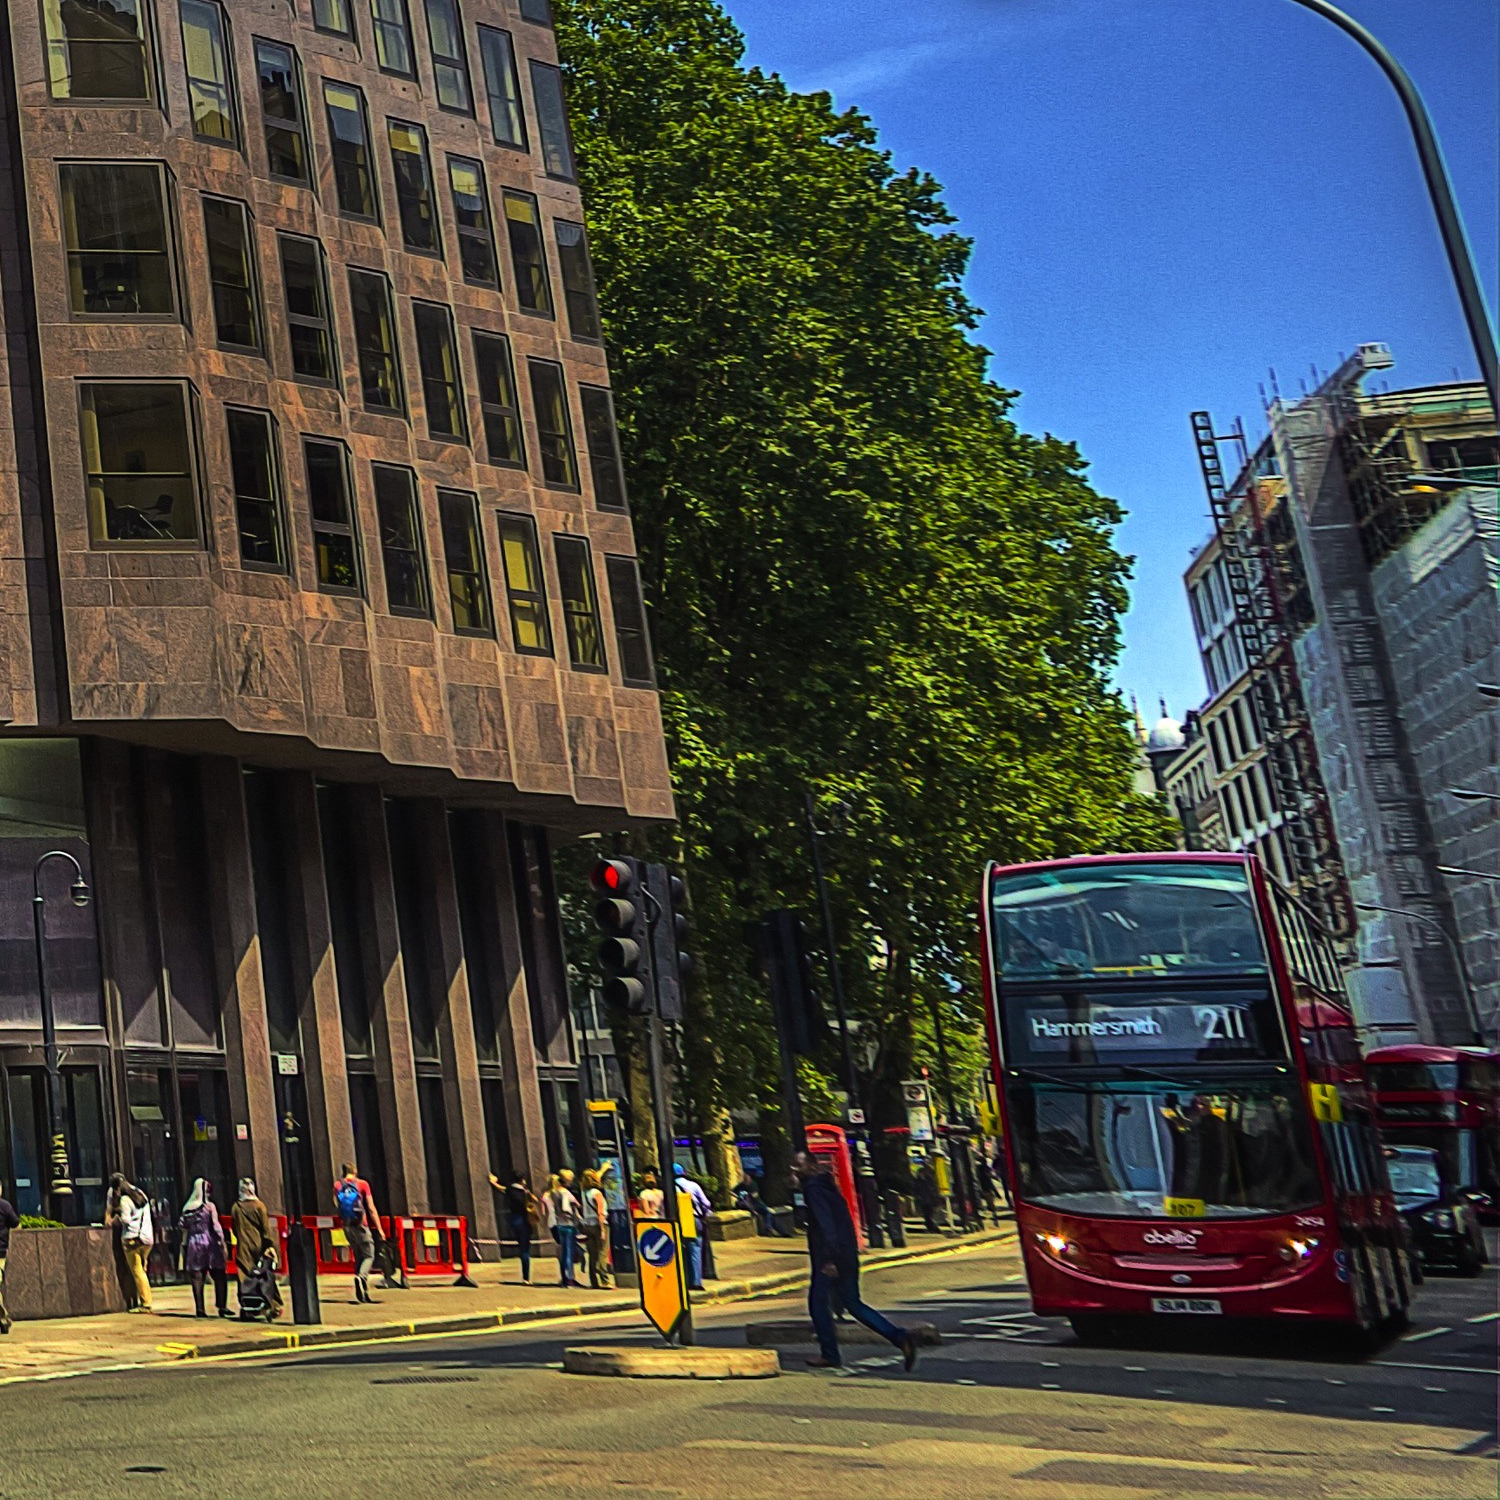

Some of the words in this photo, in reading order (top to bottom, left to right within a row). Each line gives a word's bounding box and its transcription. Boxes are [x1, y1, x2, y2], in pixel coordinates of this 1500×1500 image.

[1031, 1016, 1162, 1037] Hammersmith
[1200, 1008, 1246, 1039] 211
[1144, 1229, 1200, 1247] abellio
